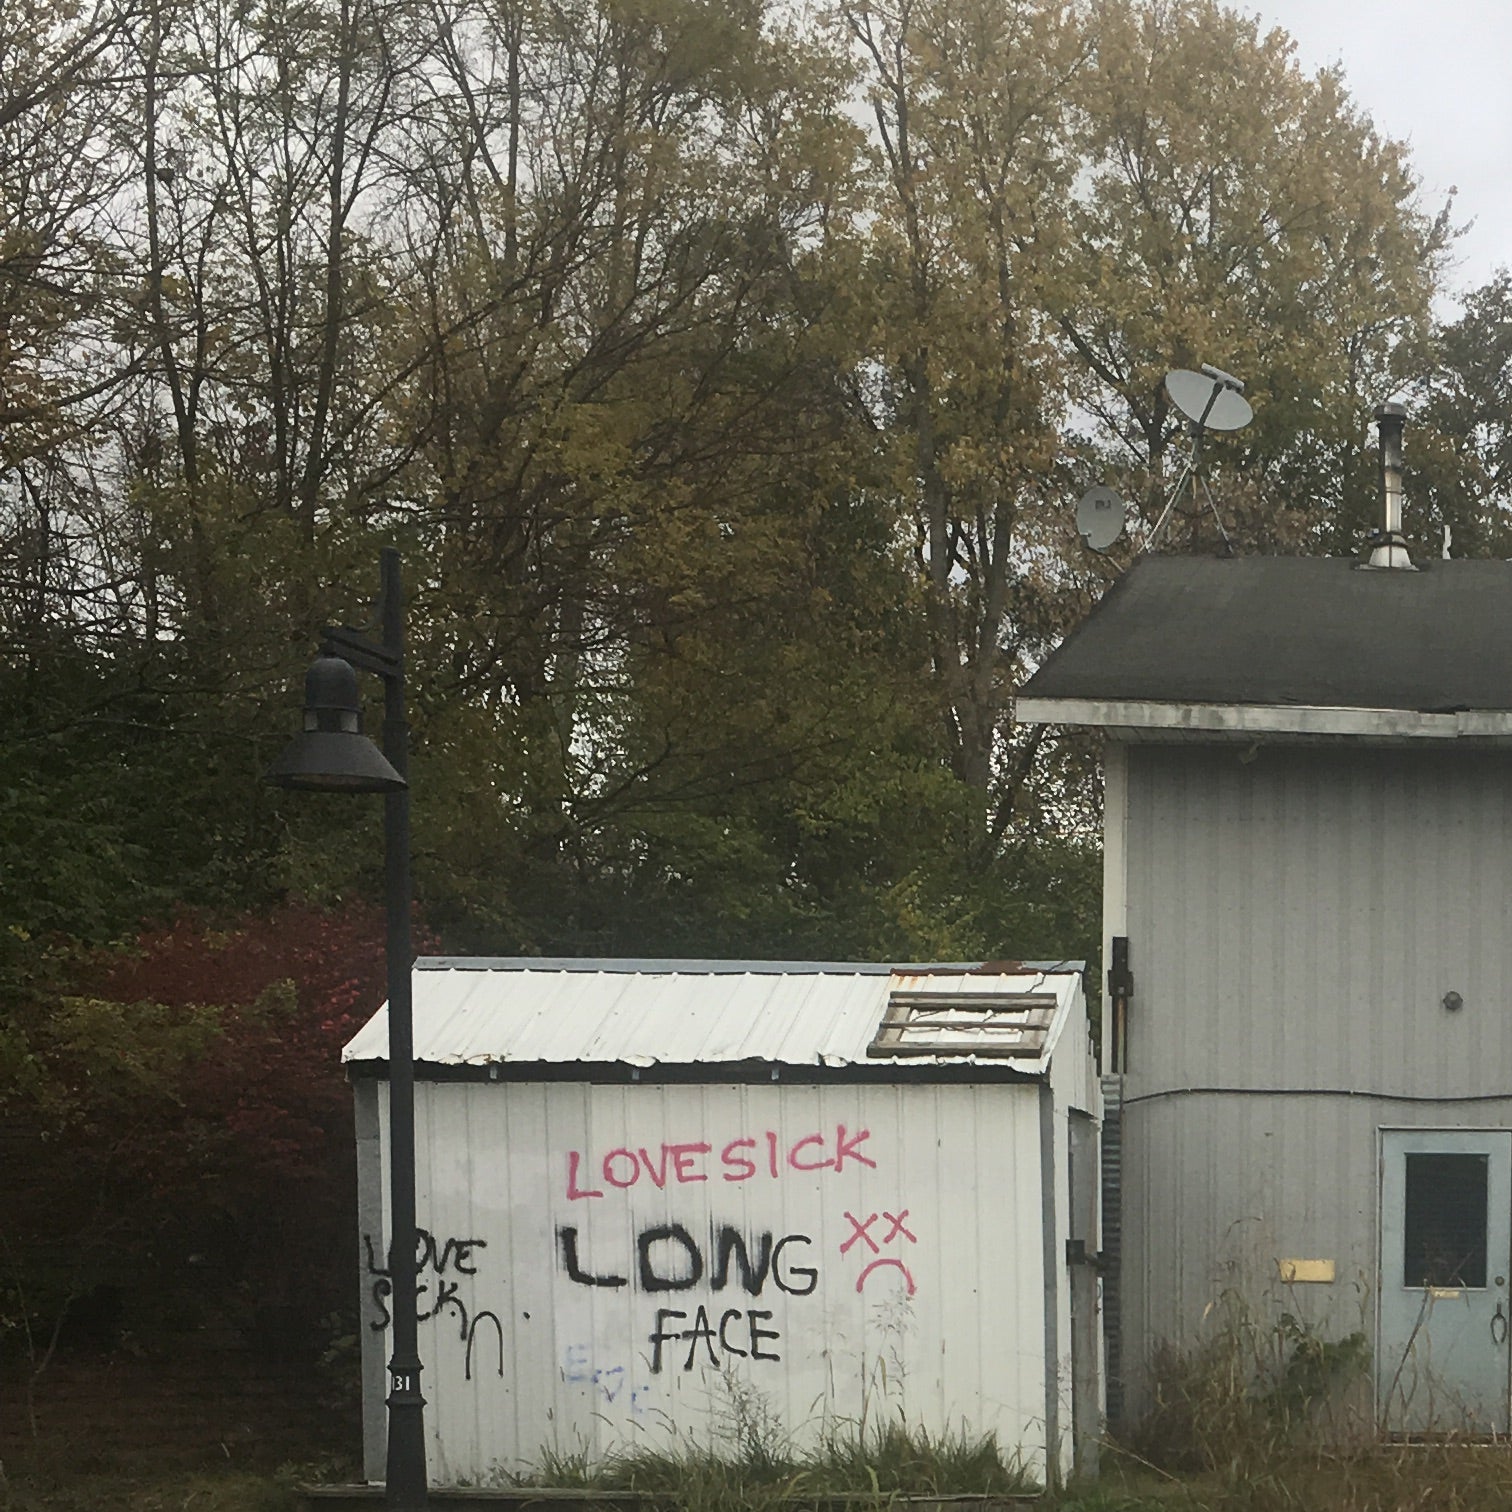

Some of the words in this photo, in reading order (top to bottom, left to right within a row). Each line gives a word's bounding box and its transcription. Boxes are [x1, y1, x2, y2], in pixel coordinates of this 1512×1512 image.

[566, 1124, 877, 1201] LOVESICK
[558, 1222, 820, 1297] LONG
[648, 1304, 781, 1375] FACE
